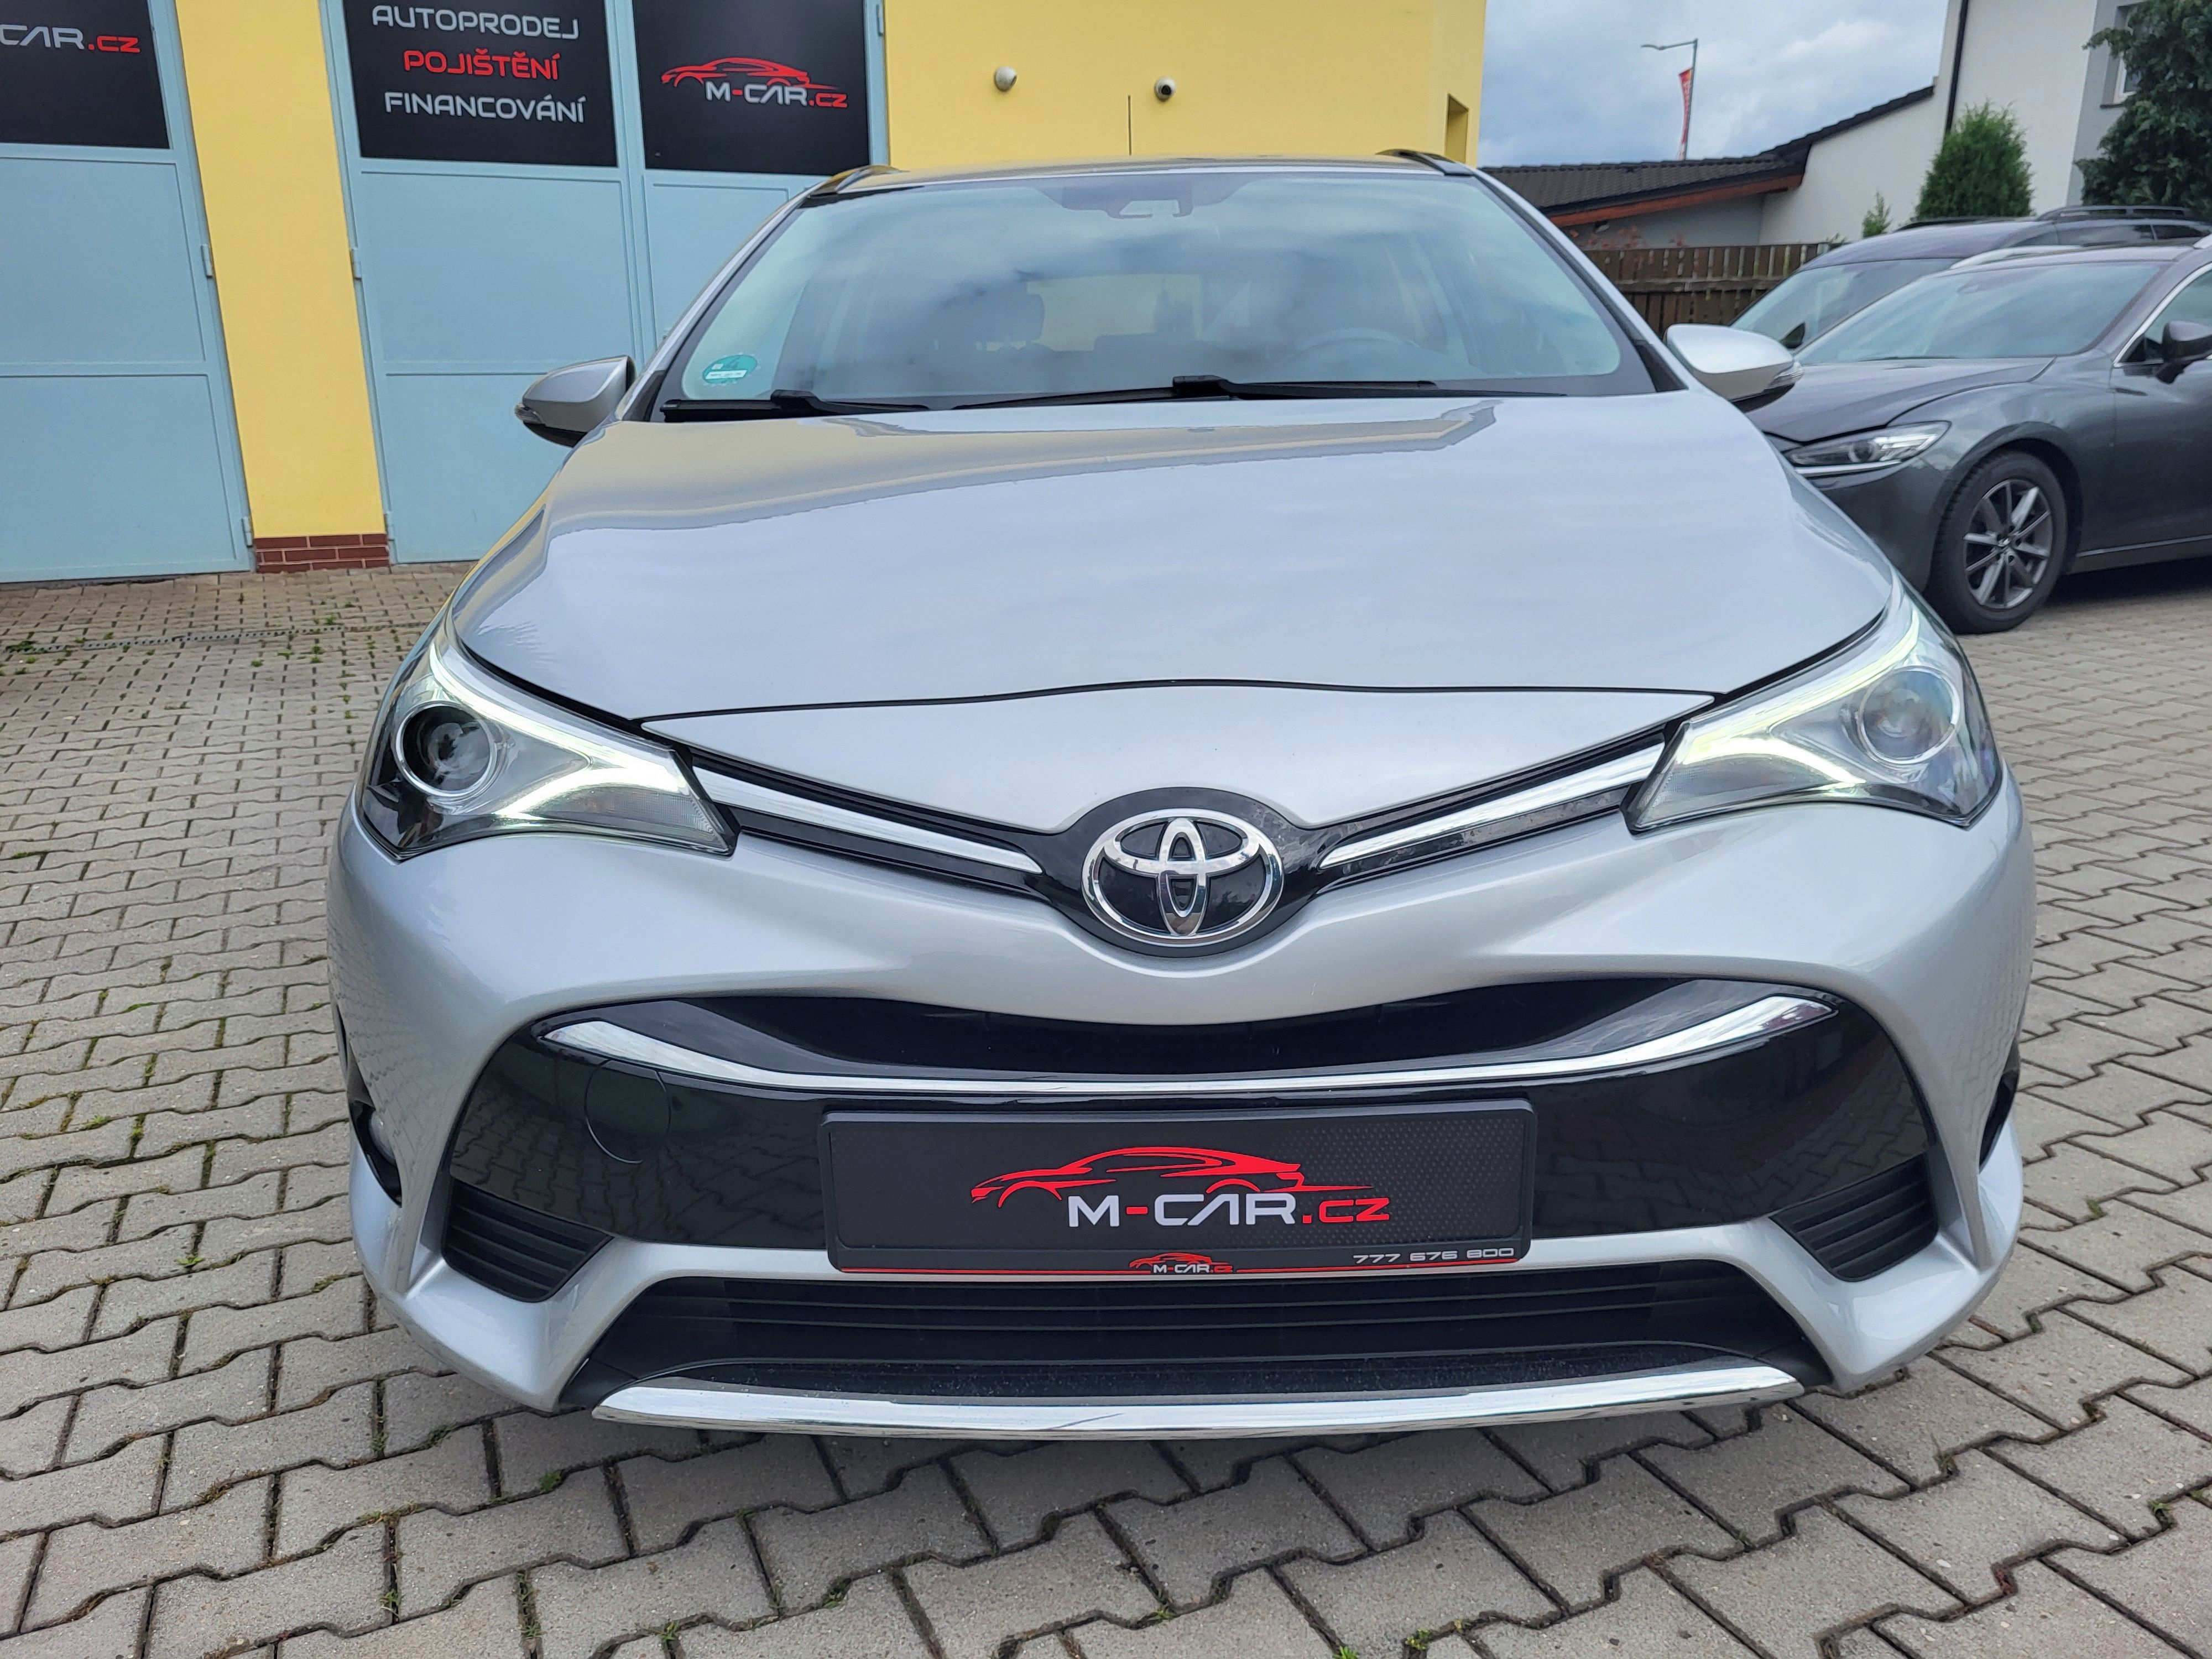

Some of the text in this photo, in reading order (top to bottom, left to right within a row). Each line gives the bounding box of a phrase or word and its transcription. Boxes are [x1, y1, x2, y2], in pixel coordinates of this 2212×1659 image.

[372, 4, 579, 40] AUTOPRODEJ
[403, 48, 561, 80] POJIŠTĚNÍ
[384, 92, 587, 123] FINANCOVÁNÍ
[1353, 1248, 1514, 1264] 777 676 800
